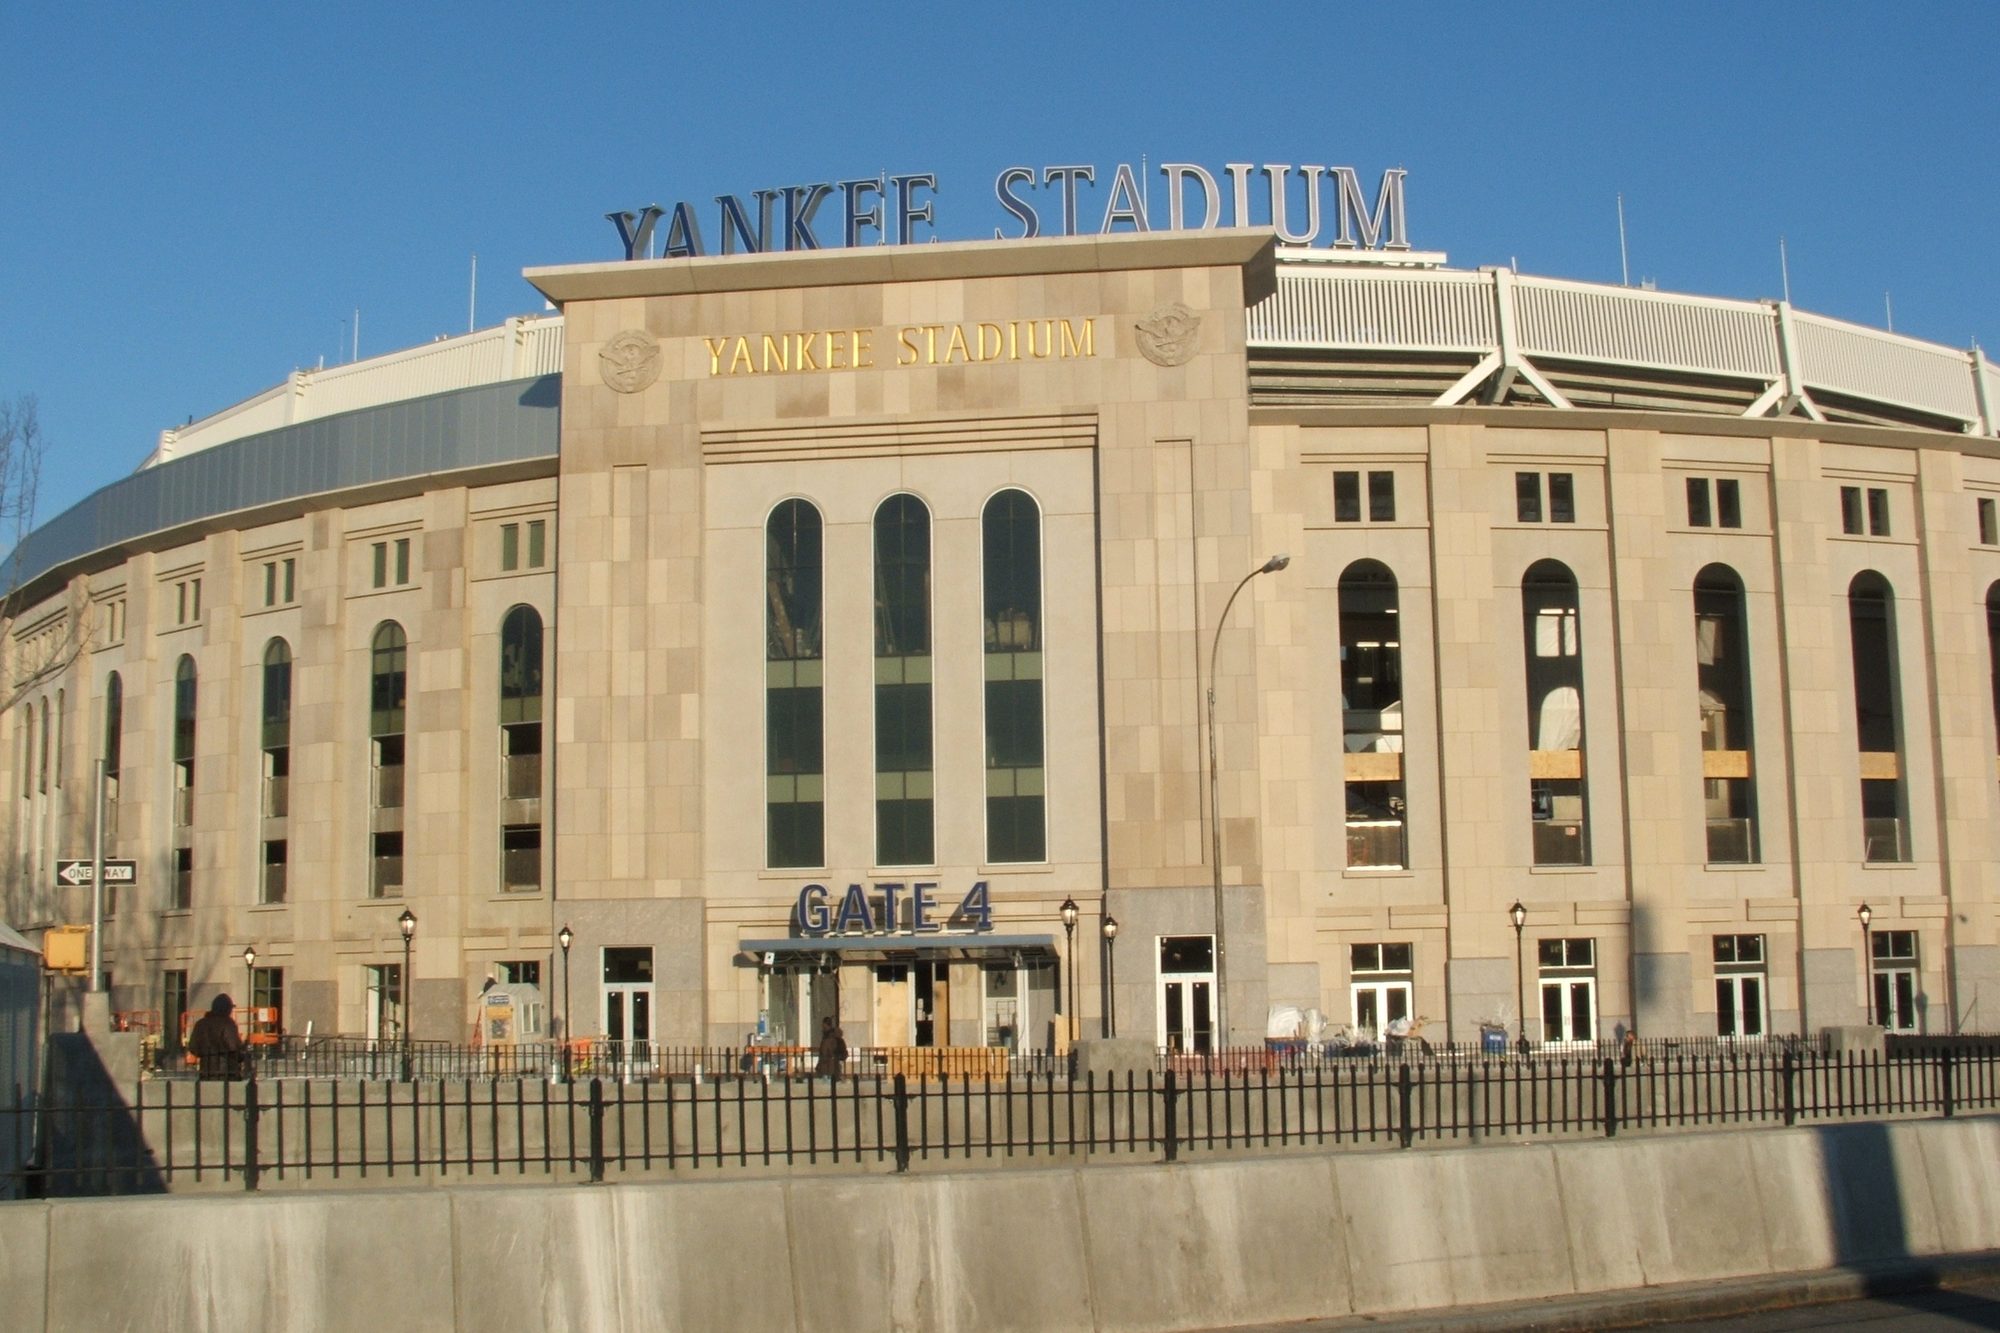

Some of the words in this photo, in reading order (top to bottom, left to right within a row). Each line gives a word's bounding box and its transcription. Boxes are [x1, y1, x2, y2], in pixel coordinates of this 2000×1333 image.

[605, 173, 937, 261] YANKEE
[994, 163, 1412, 248] STADIUM
[703, 329, 874, 377] YANKEE
[897, 317, 1098, 366] STADIUM
[68, 868, 93, 879] ONE
[797, 882, 940, 933] GATE
[962, 881, 994, 930] 4
